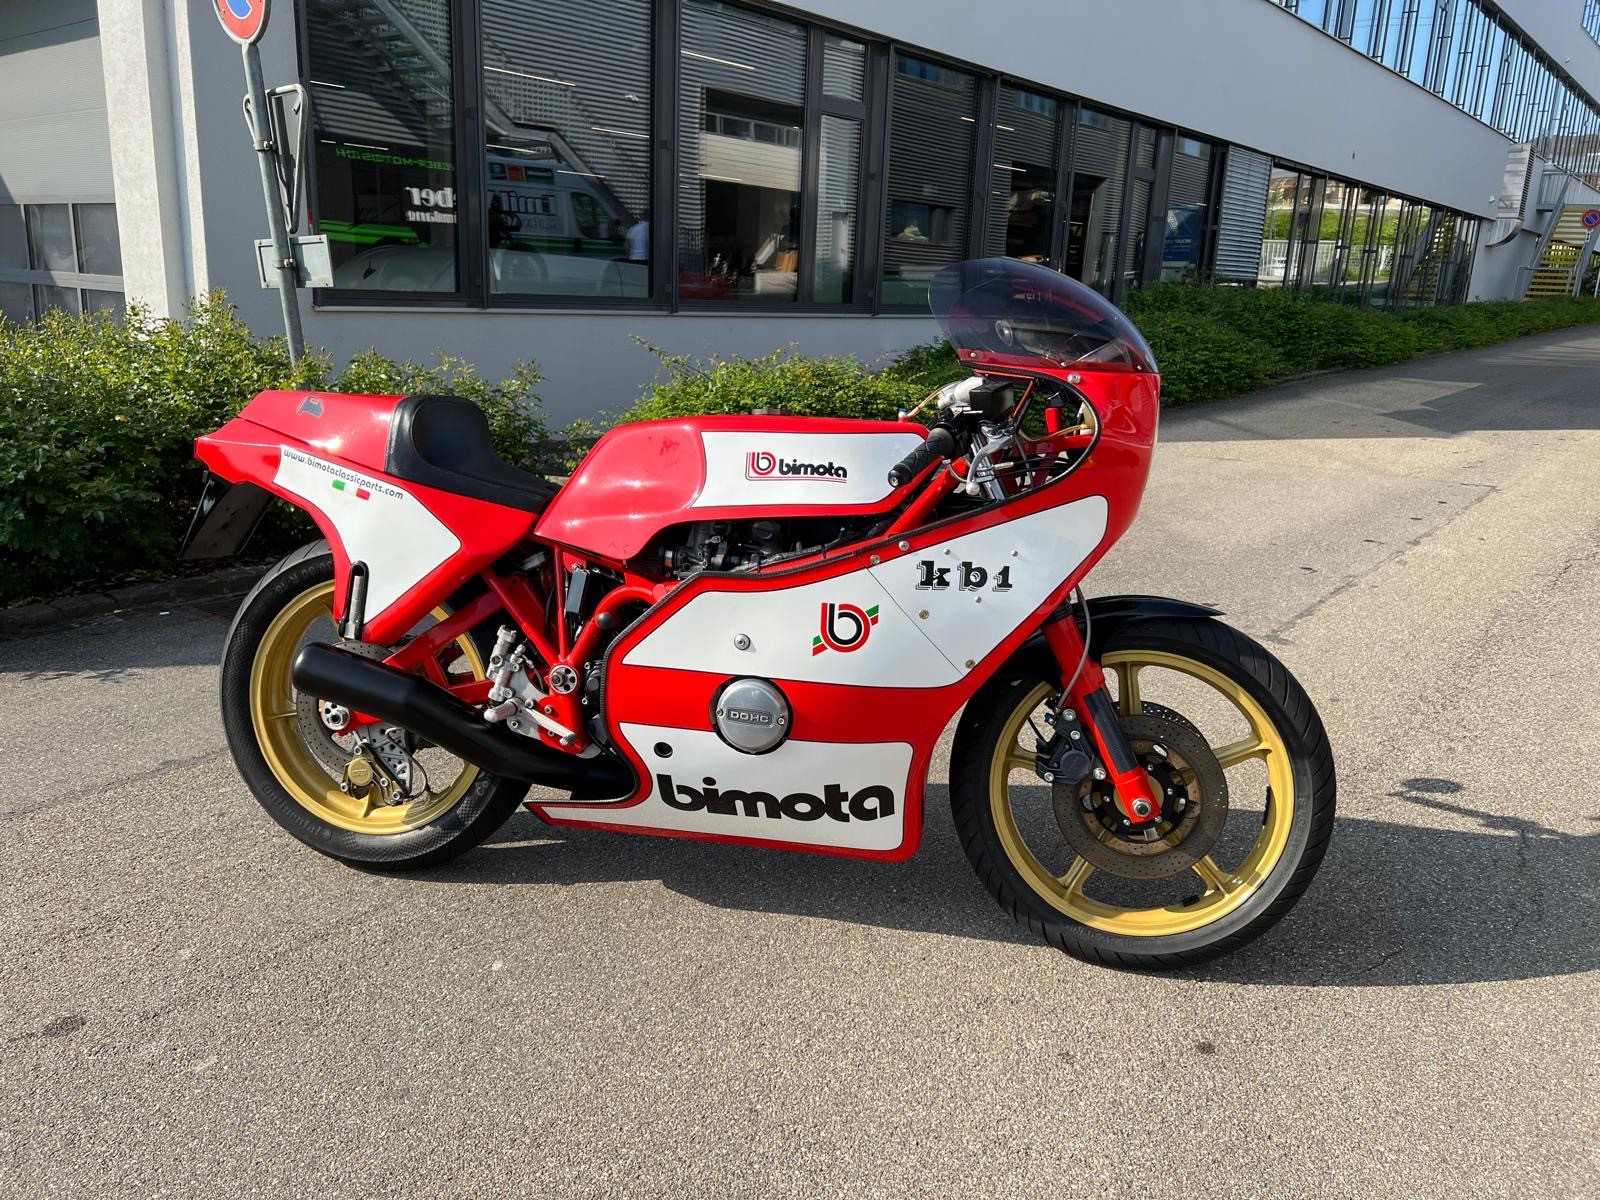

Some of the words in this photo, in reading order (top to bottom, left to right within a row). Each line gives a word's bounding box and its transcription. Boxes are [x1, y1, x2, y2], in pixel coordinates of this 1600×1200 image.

[283, 449, 404, 500] www.bimotaclassicparts.com
[779, 459, 848, 479] bimota
[730, 710, 769, 723] DOHC
[656, 773, 895, 822] bimota
